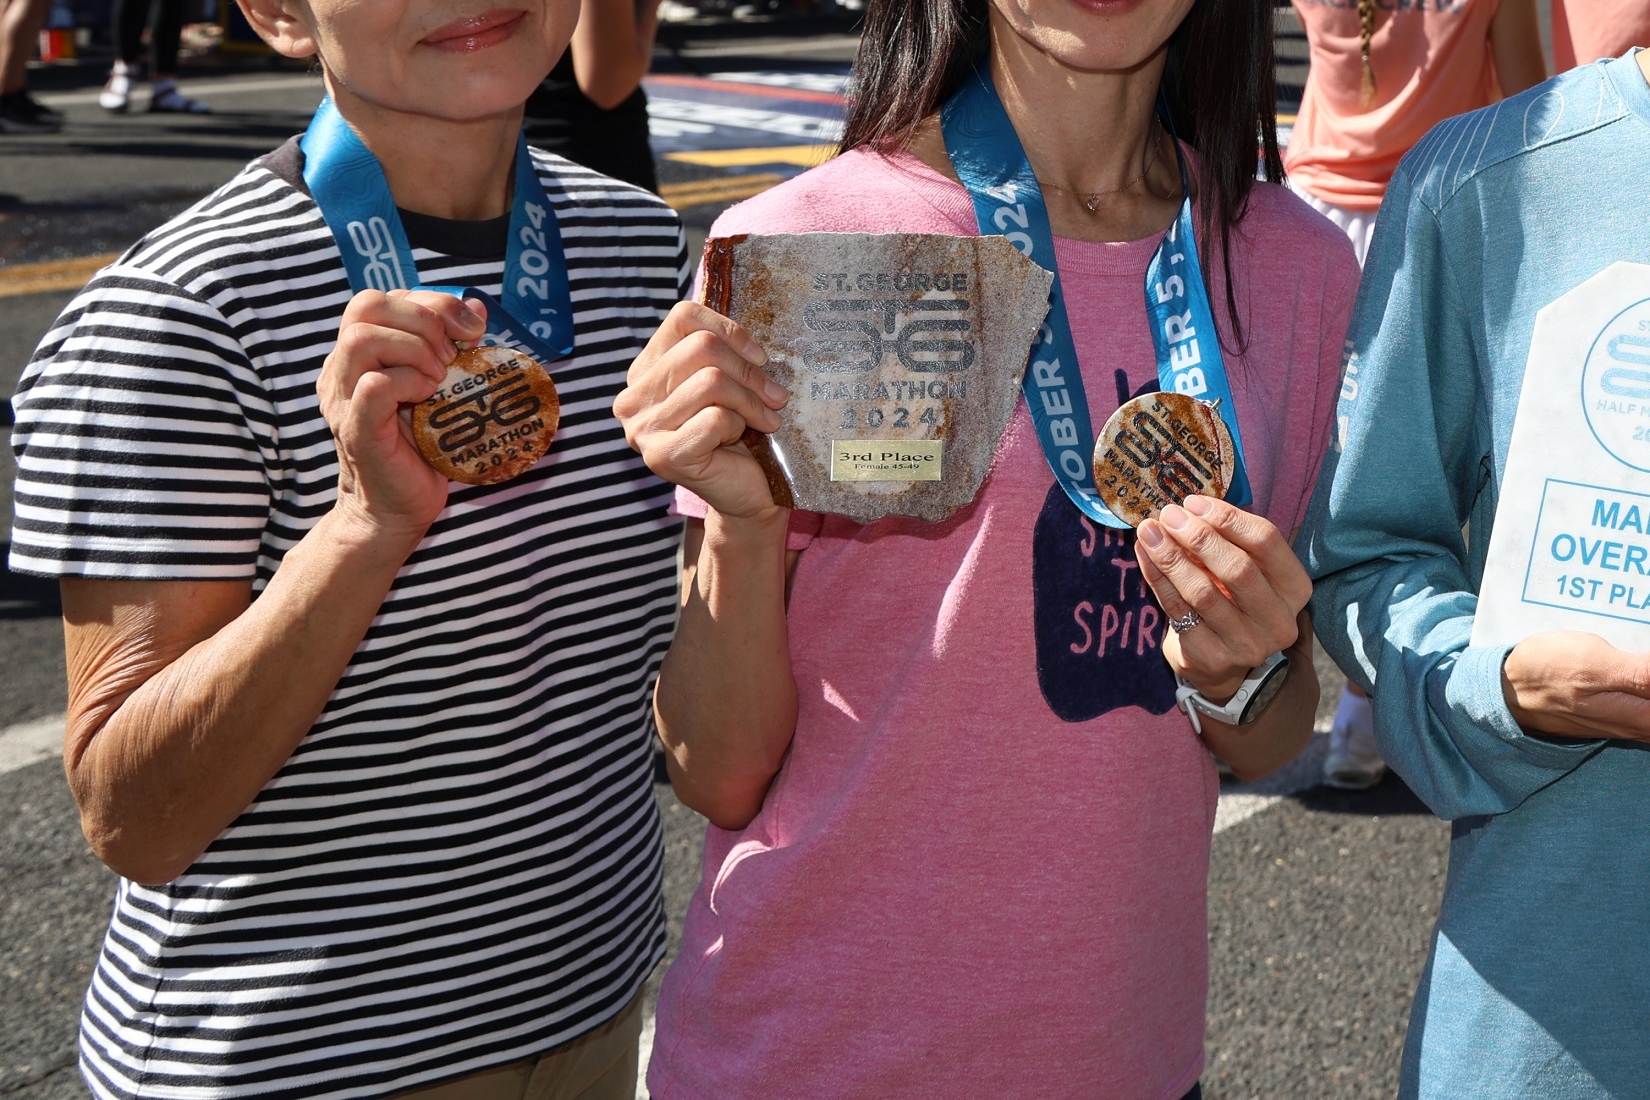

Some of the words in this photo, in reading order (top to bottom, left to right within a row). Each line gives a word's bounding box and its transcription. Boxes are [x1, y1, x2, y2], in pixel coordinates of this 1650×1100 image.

[517, 201, 550, 300] 2024
[812, 273, 968, 293] ST.GEORGE
[810, 381, 967, 400] MARATHON
[1596, 399, 1636, 415] HALF
[450, 417, 544, 467] MARATHON
[1151, 401, 1223, 470] ST.GEORGE
[839, 452, 872, 462] 3rd
[881, 452, 934, 462] Place
[1104, 448, 1168, 510] MARATHO
[1555, 574, 1603, 601] 1ST
[1070, 601, 1163, 658] SPIR
